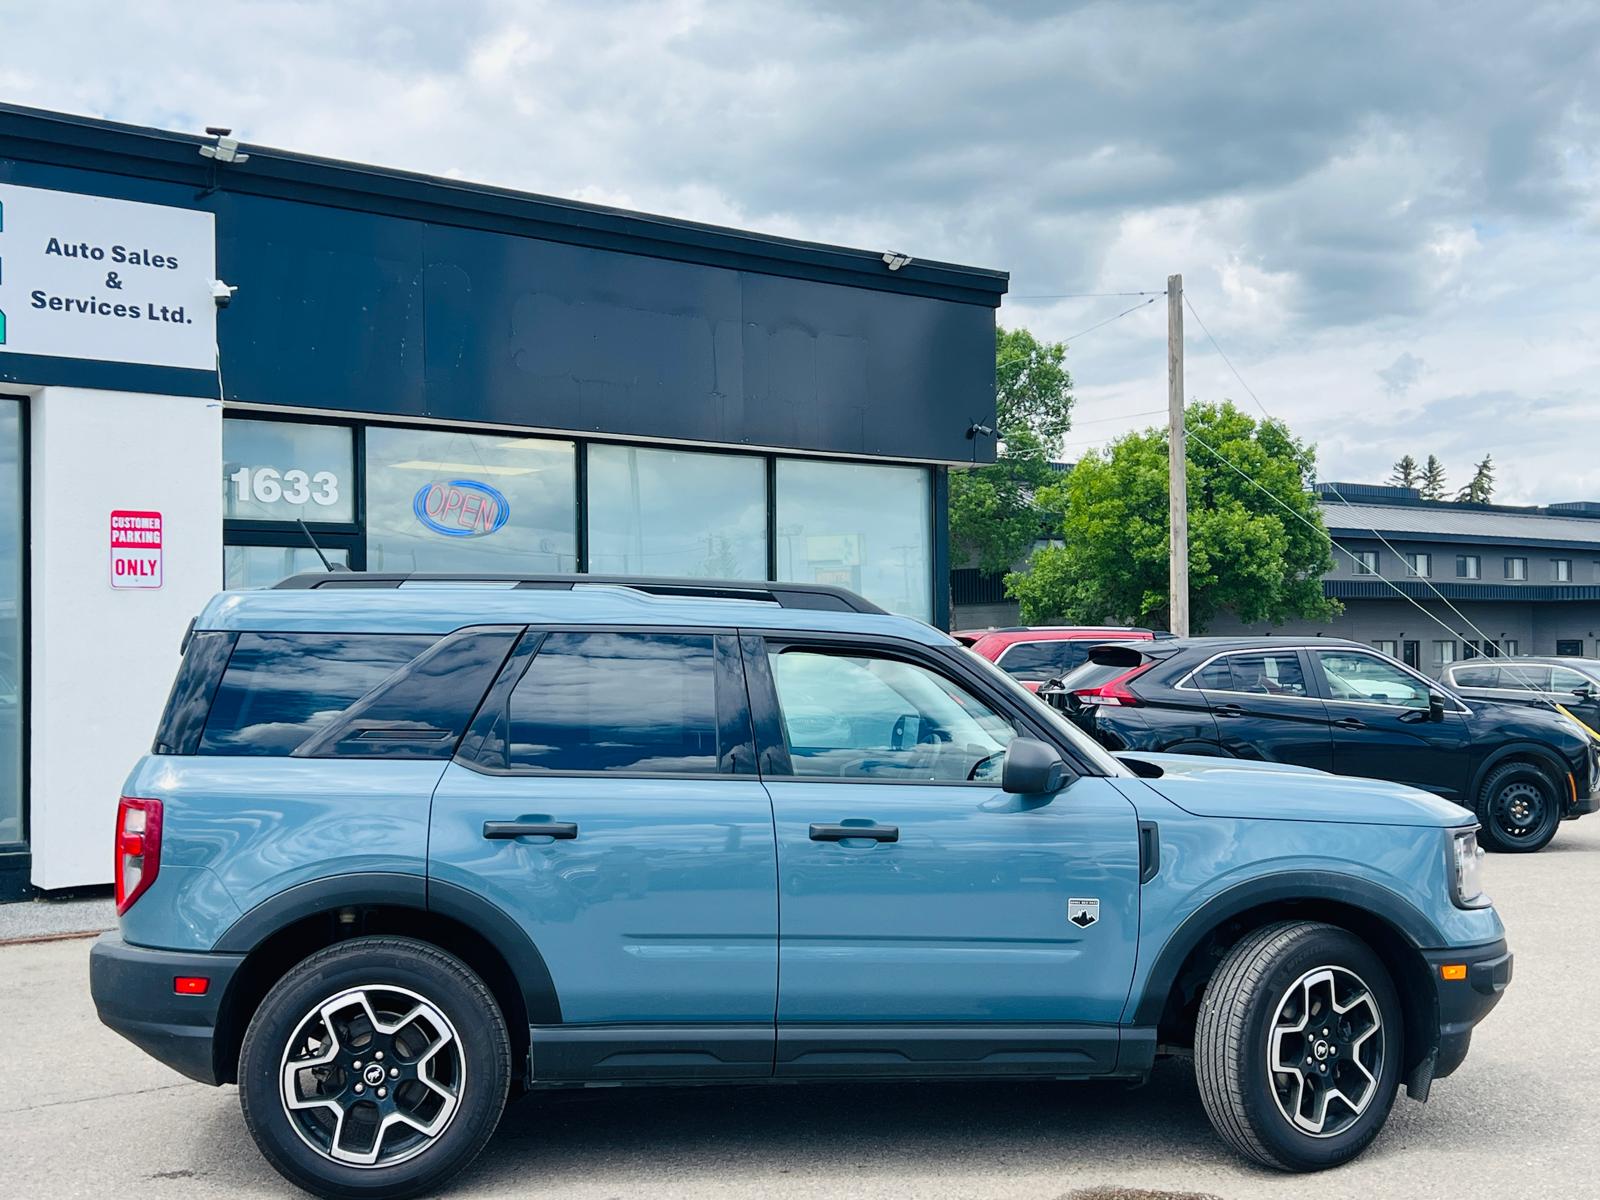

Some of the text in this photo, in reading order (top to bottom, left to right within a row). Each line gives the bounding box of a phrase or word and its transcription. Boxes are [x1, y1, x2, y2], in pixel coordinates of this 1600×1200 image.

[45, 237, 179, 270] Auto Sales
[105, 271, 123, 290] &
[30, 290, 193, 324] Services Ltd.
[230, 467, 339, 506] 1633
[425, 482, 498, 531] OPEN
[111, 516, 161, 529] CUSTOMER
[111, 530, 161, 543] PARKING
[115, 558, 157, 576] ONLY
